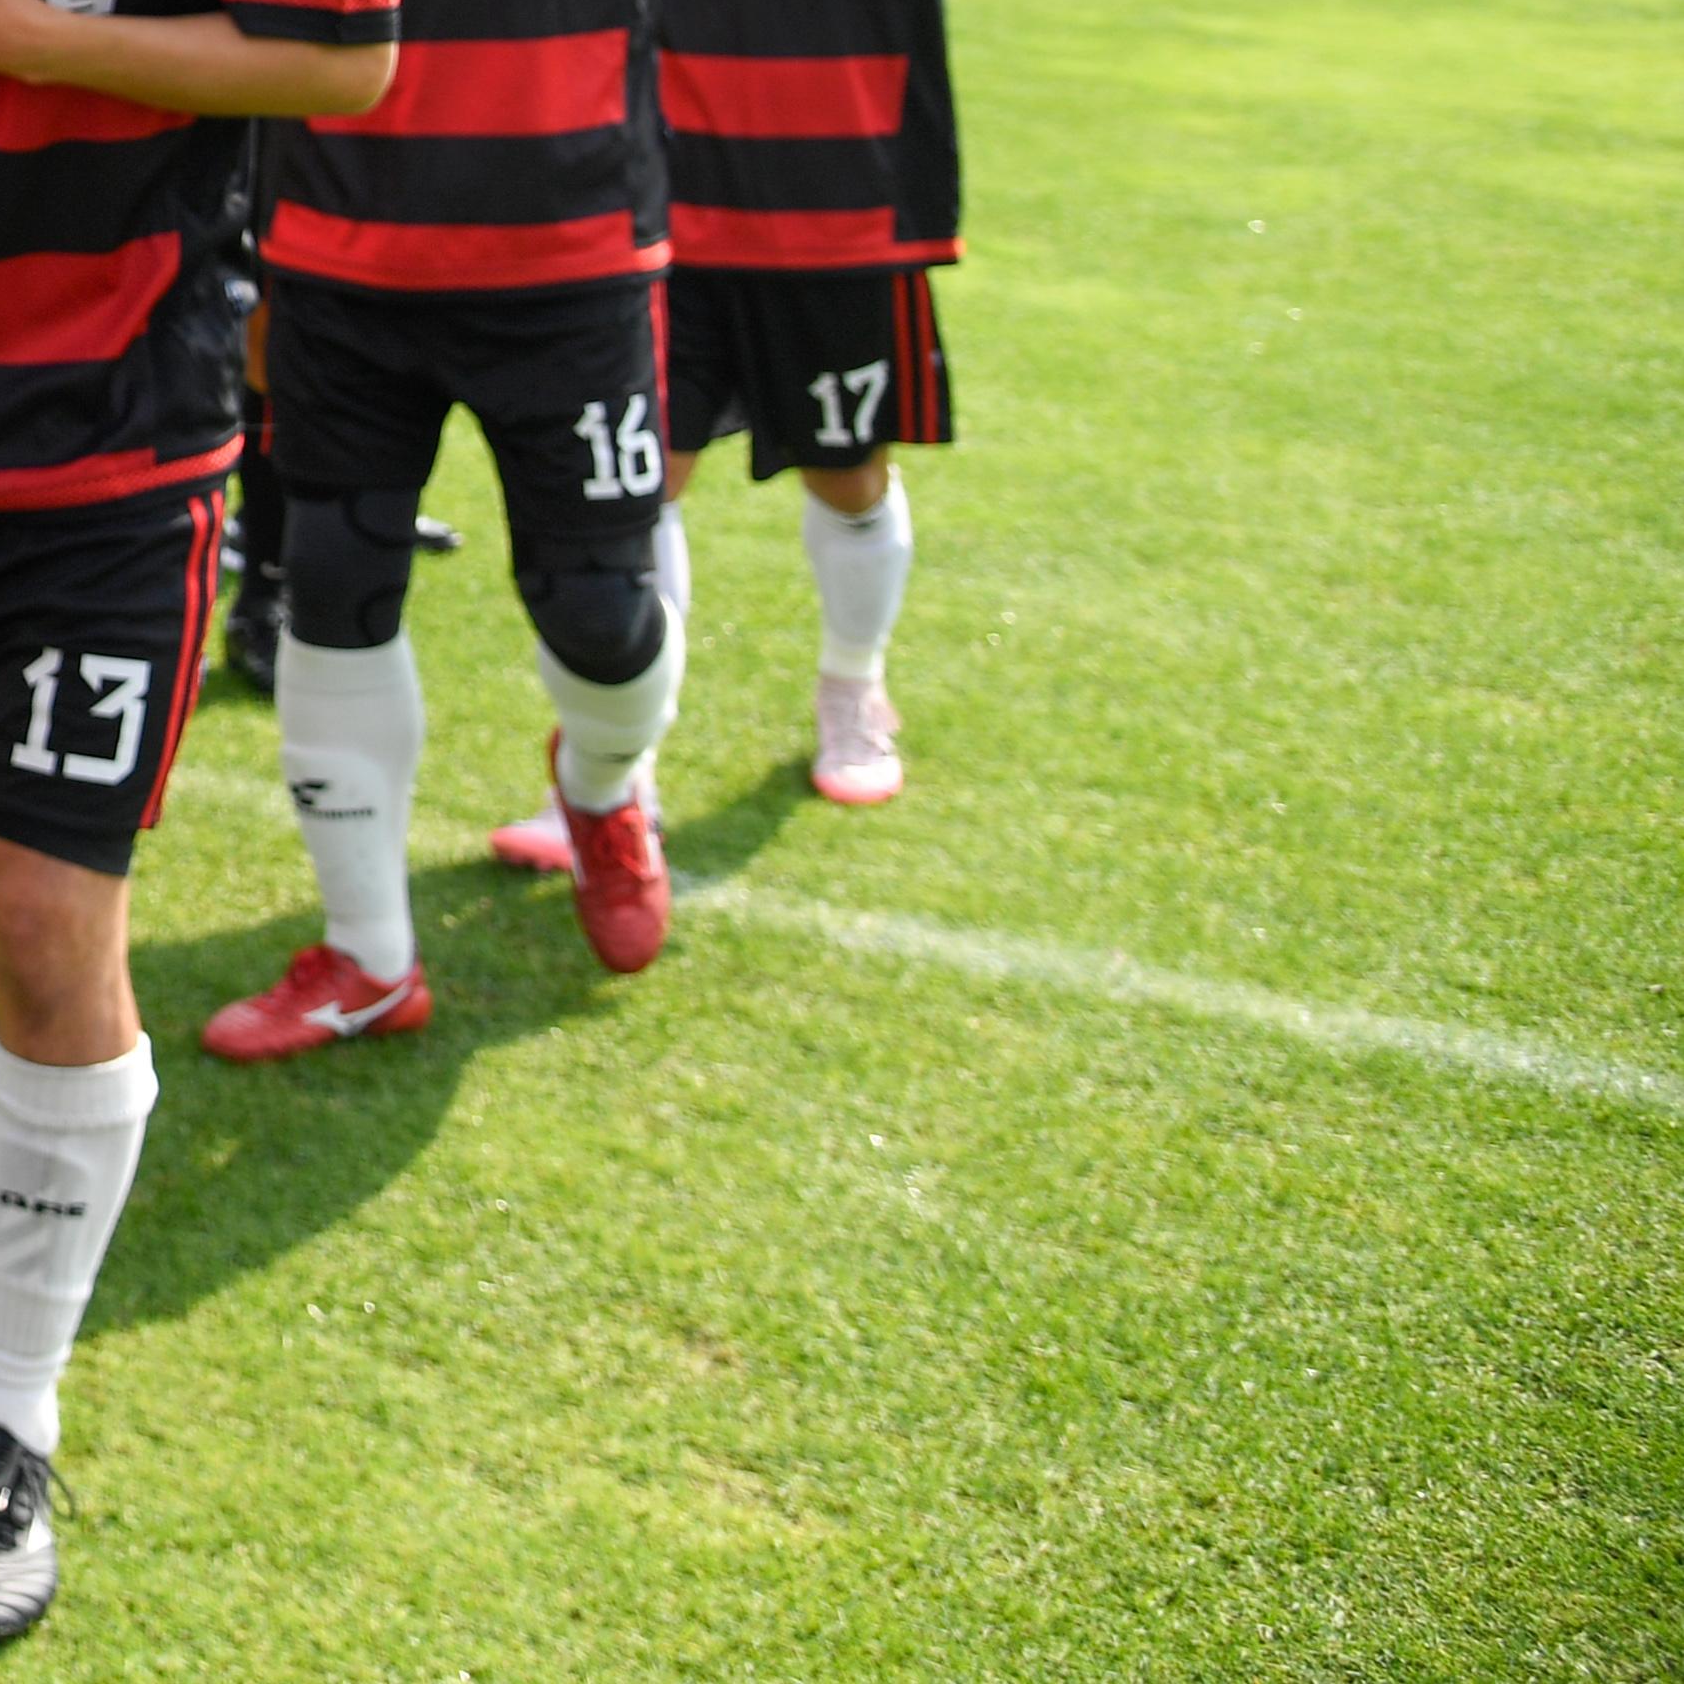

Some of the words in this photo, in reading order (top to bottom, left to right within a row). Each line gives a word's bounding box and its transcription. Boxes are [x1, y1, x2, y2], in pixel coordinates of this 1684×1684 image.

[573, 392, 665, 501] 16
[807, 359, 890, 448] 17
[9, 646, 152, 786] 13
